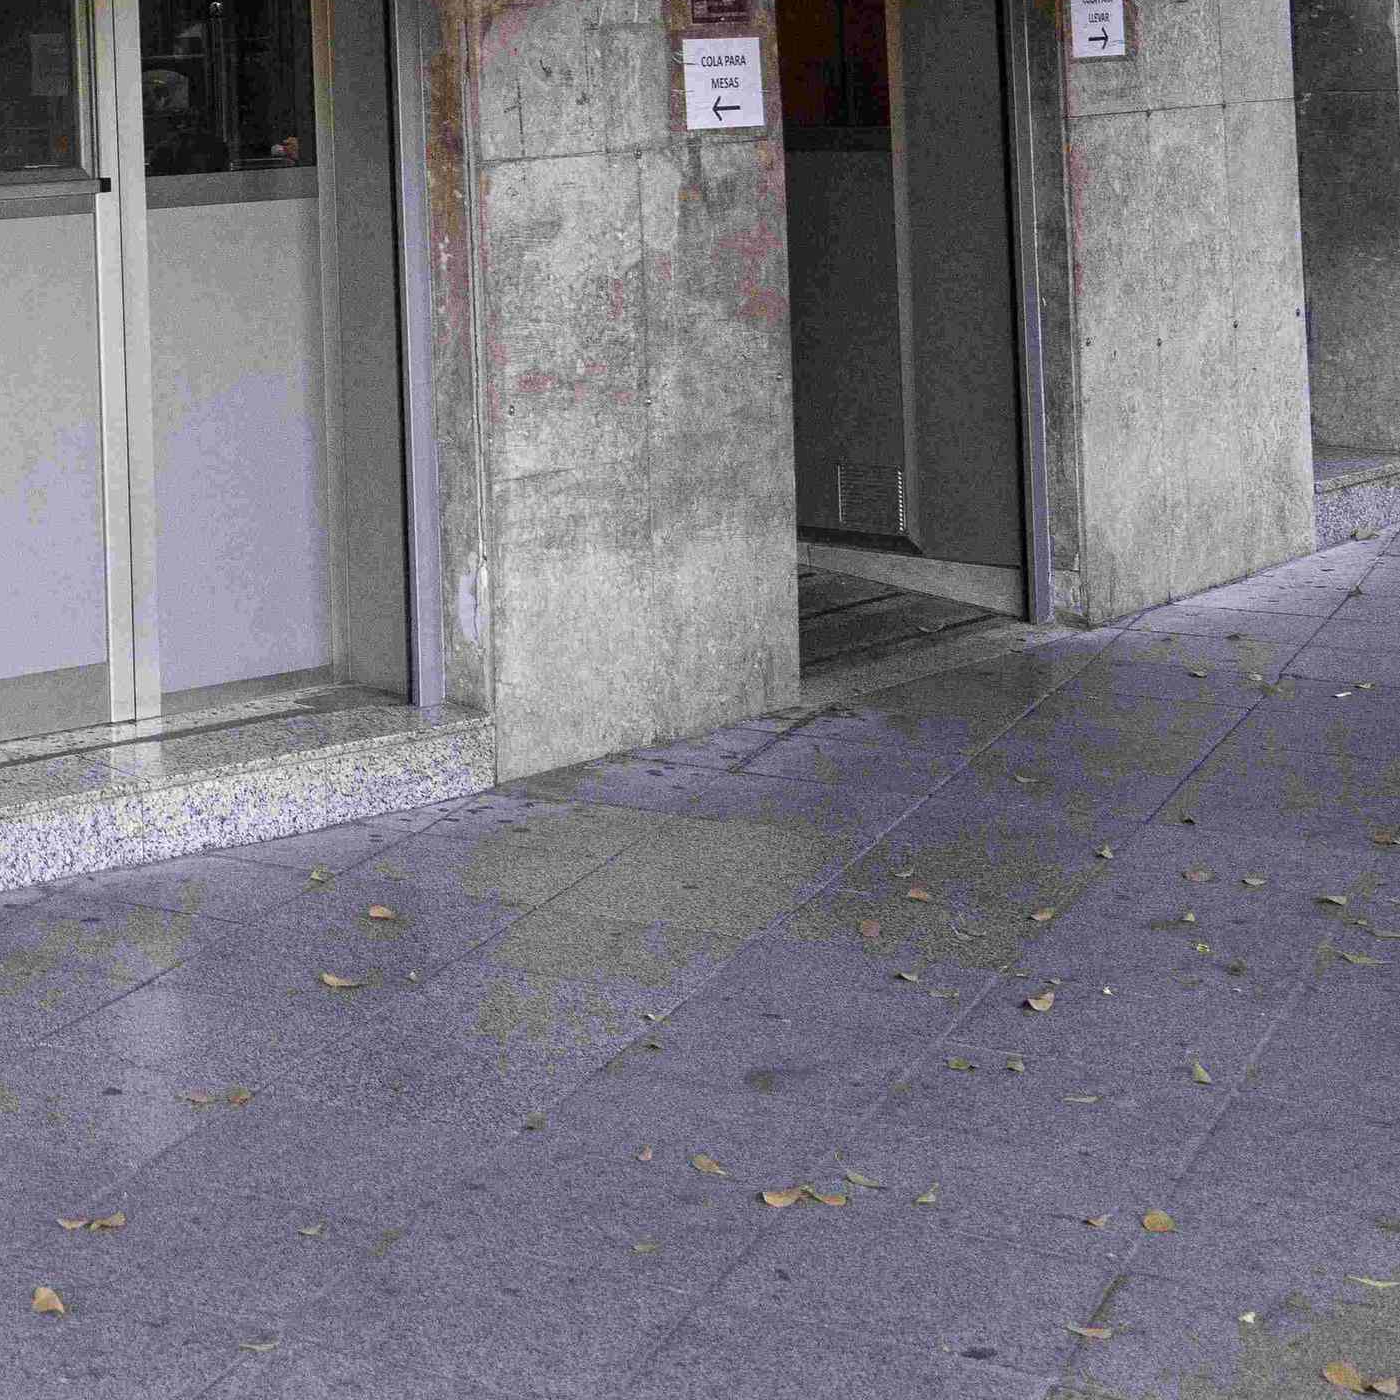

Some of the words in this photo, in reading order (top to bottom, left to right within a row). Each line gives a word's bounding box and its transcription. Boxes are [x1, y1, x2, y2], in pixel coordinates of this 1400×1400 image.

[701, 56, 724, 67] COLA
[724, 55, 747, 66] PARA
[711, 77, 740, 89] MESAS
